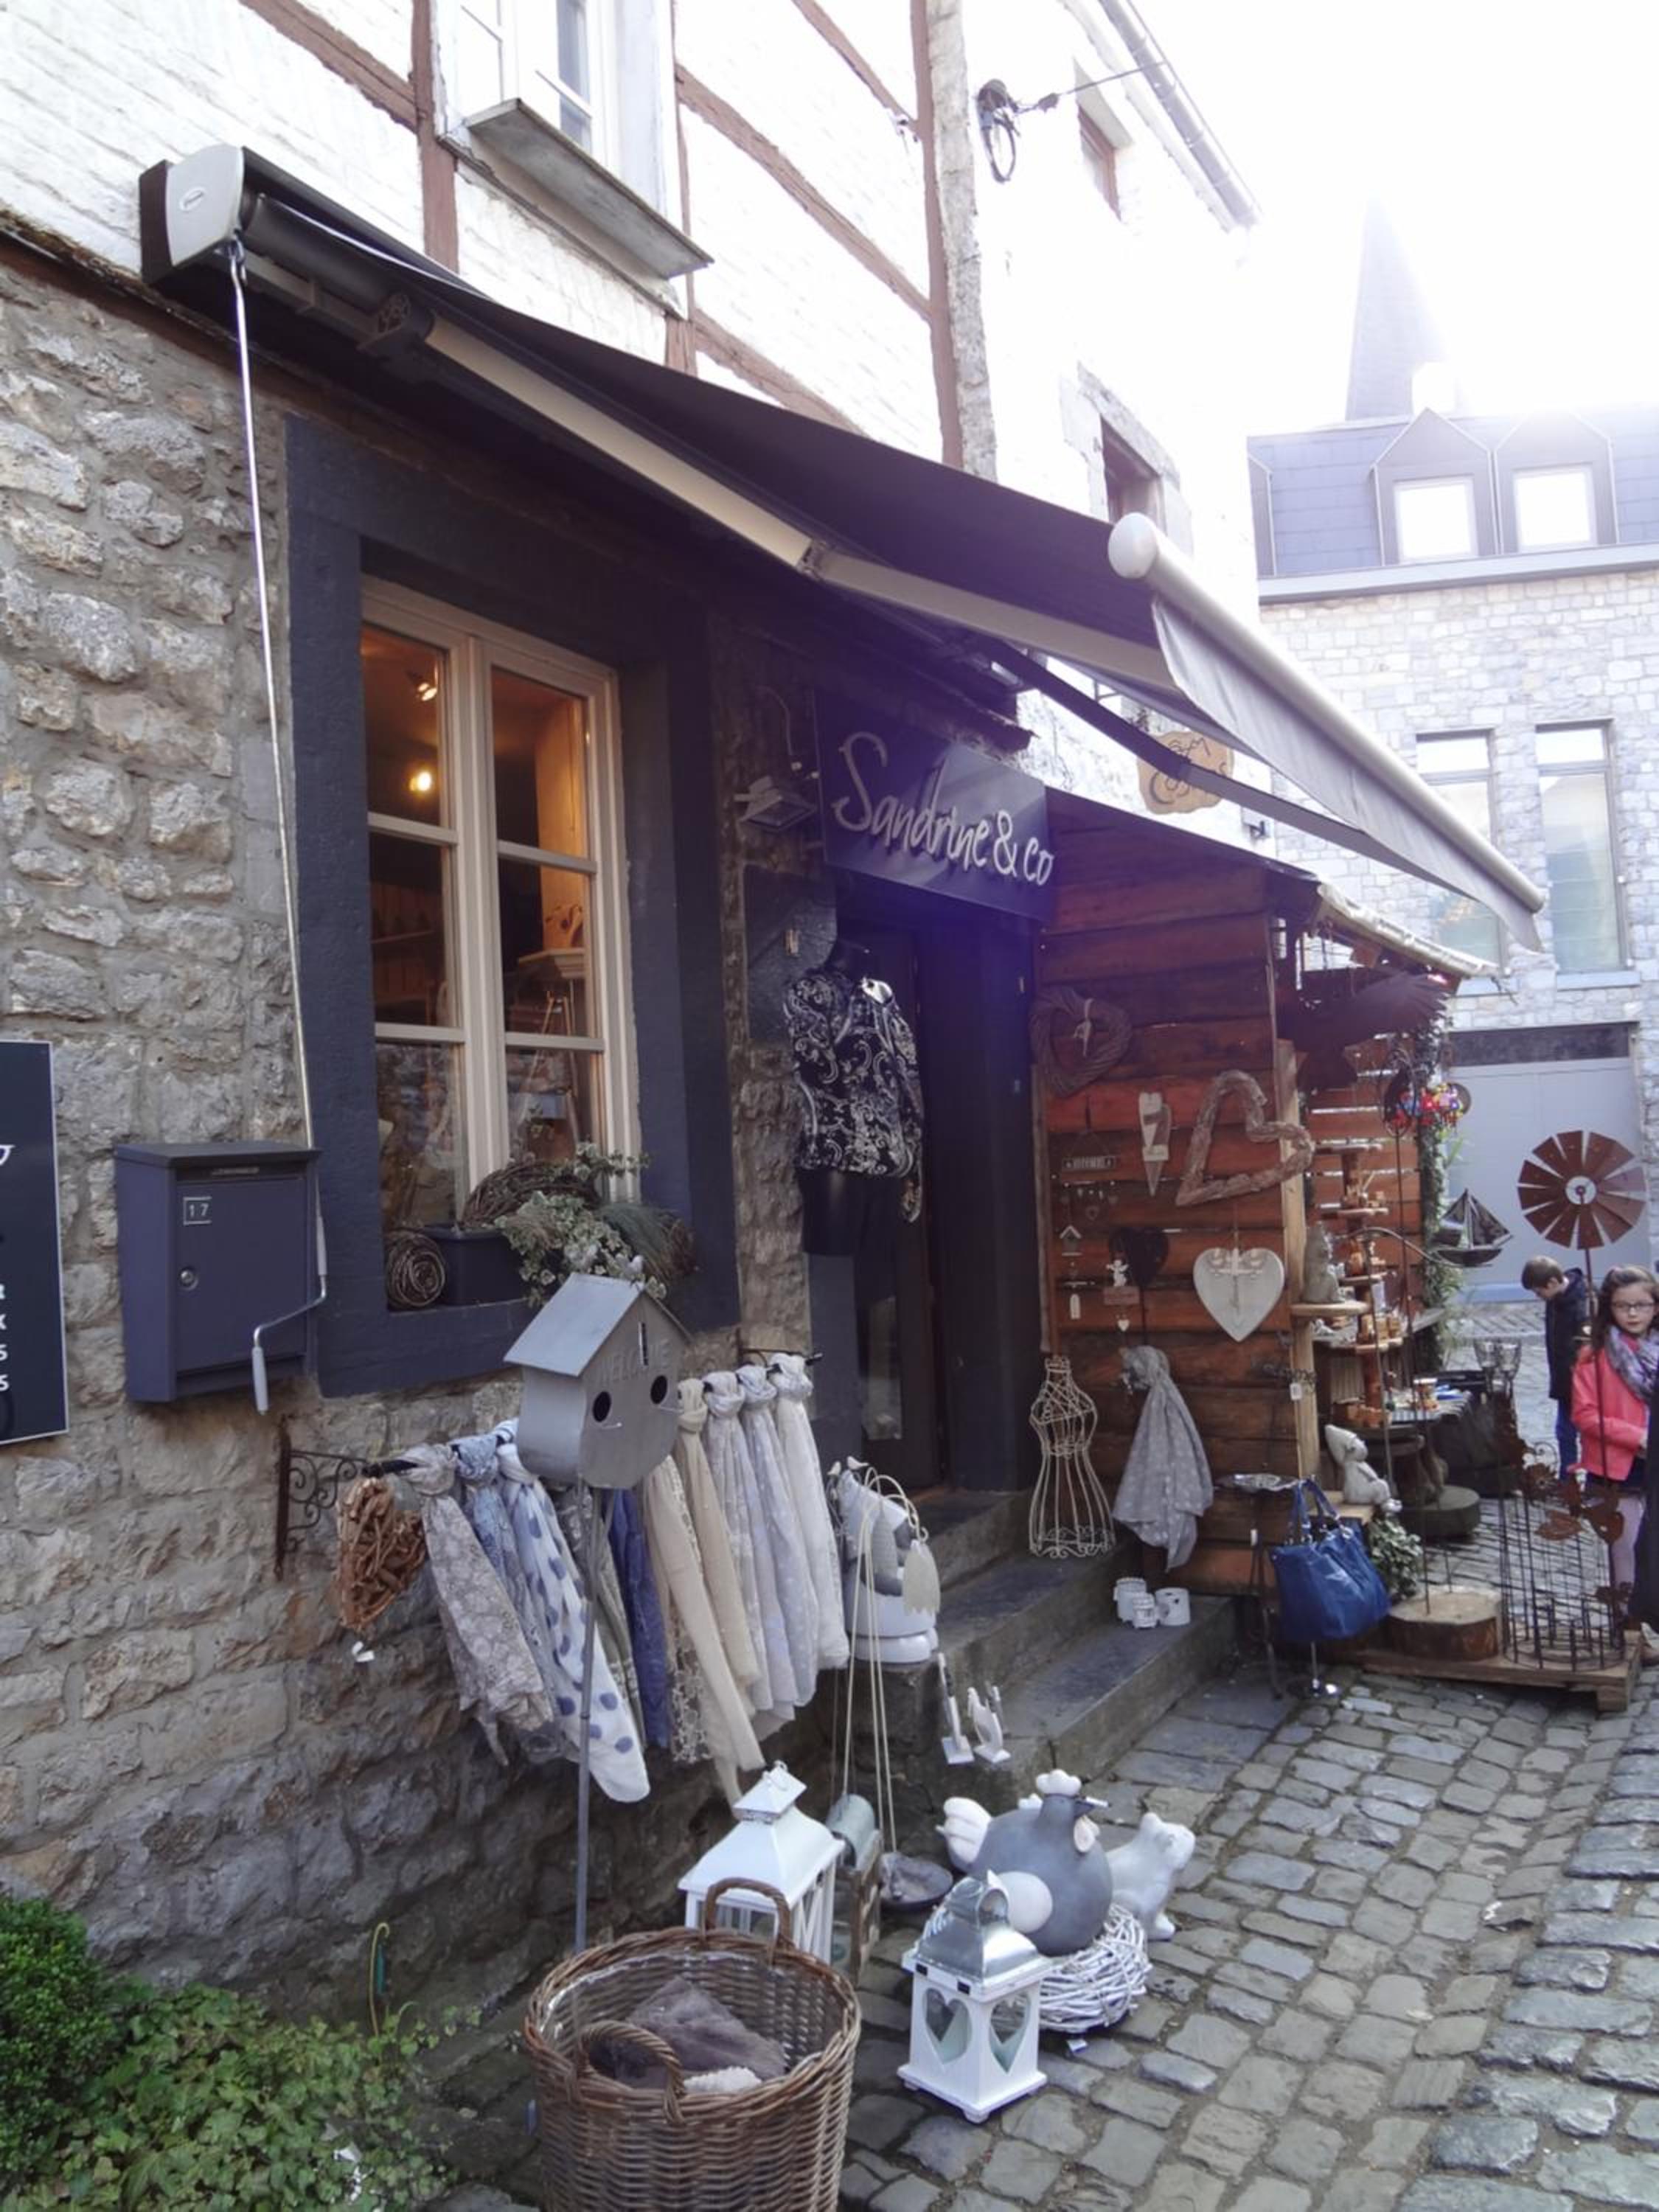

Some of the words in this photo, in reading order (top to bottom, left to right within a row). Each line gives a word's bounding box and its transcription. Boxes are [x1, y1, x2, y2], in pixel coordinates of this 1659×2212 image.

[831, 731, 990, 872] Sandrine
[994, 809, 1018, 877] &
[189, 1203, 209, 1218] 17
